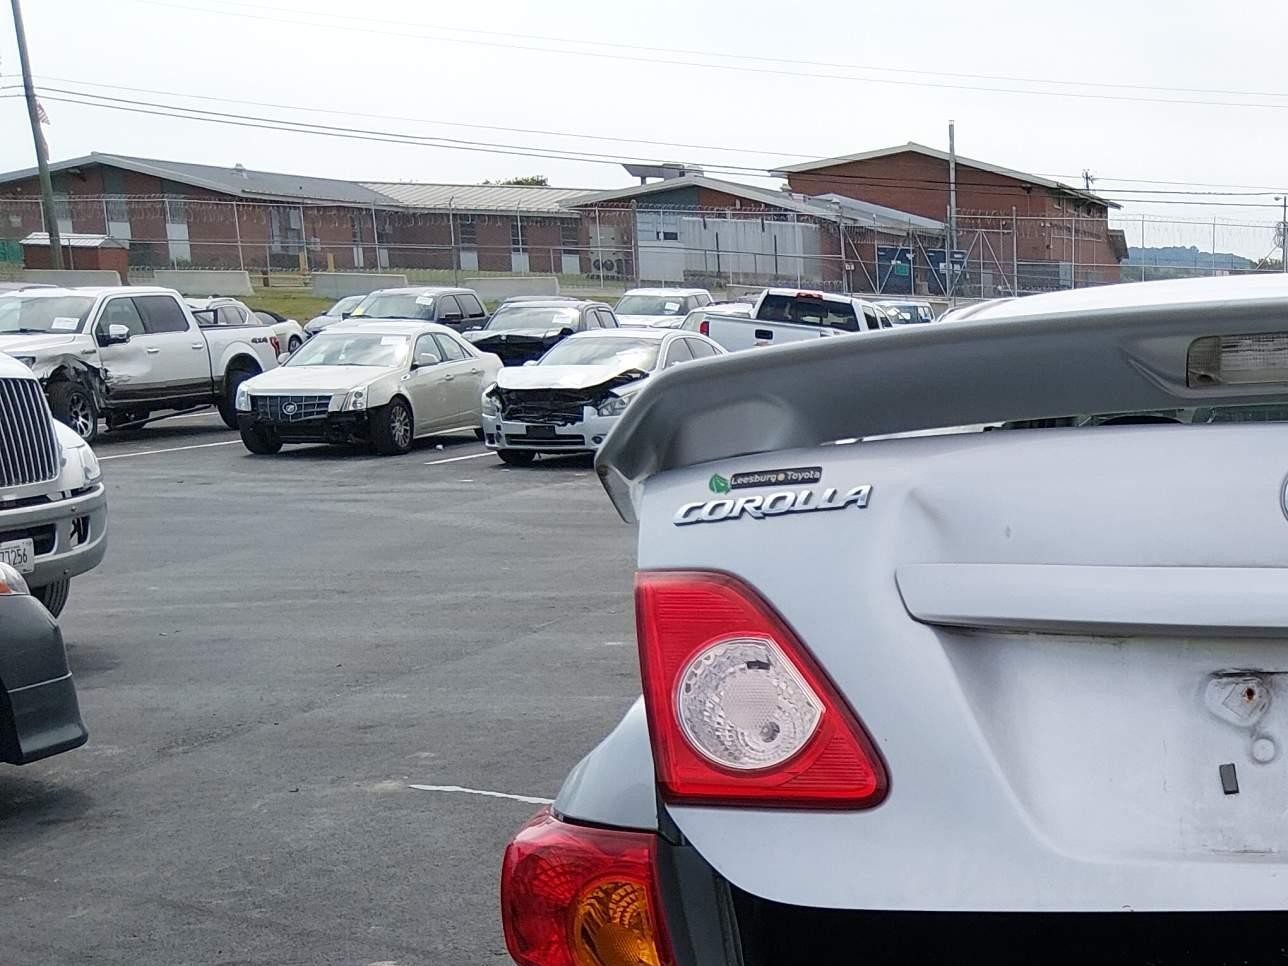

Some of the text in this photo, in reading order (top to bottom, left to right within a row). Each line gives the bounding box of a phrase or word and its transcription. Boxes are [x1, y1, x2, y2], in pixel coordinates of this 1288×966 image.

[731, 471, 821, 485] Leesburg Toyota
[673, 484, 872, 526] COROLLA
